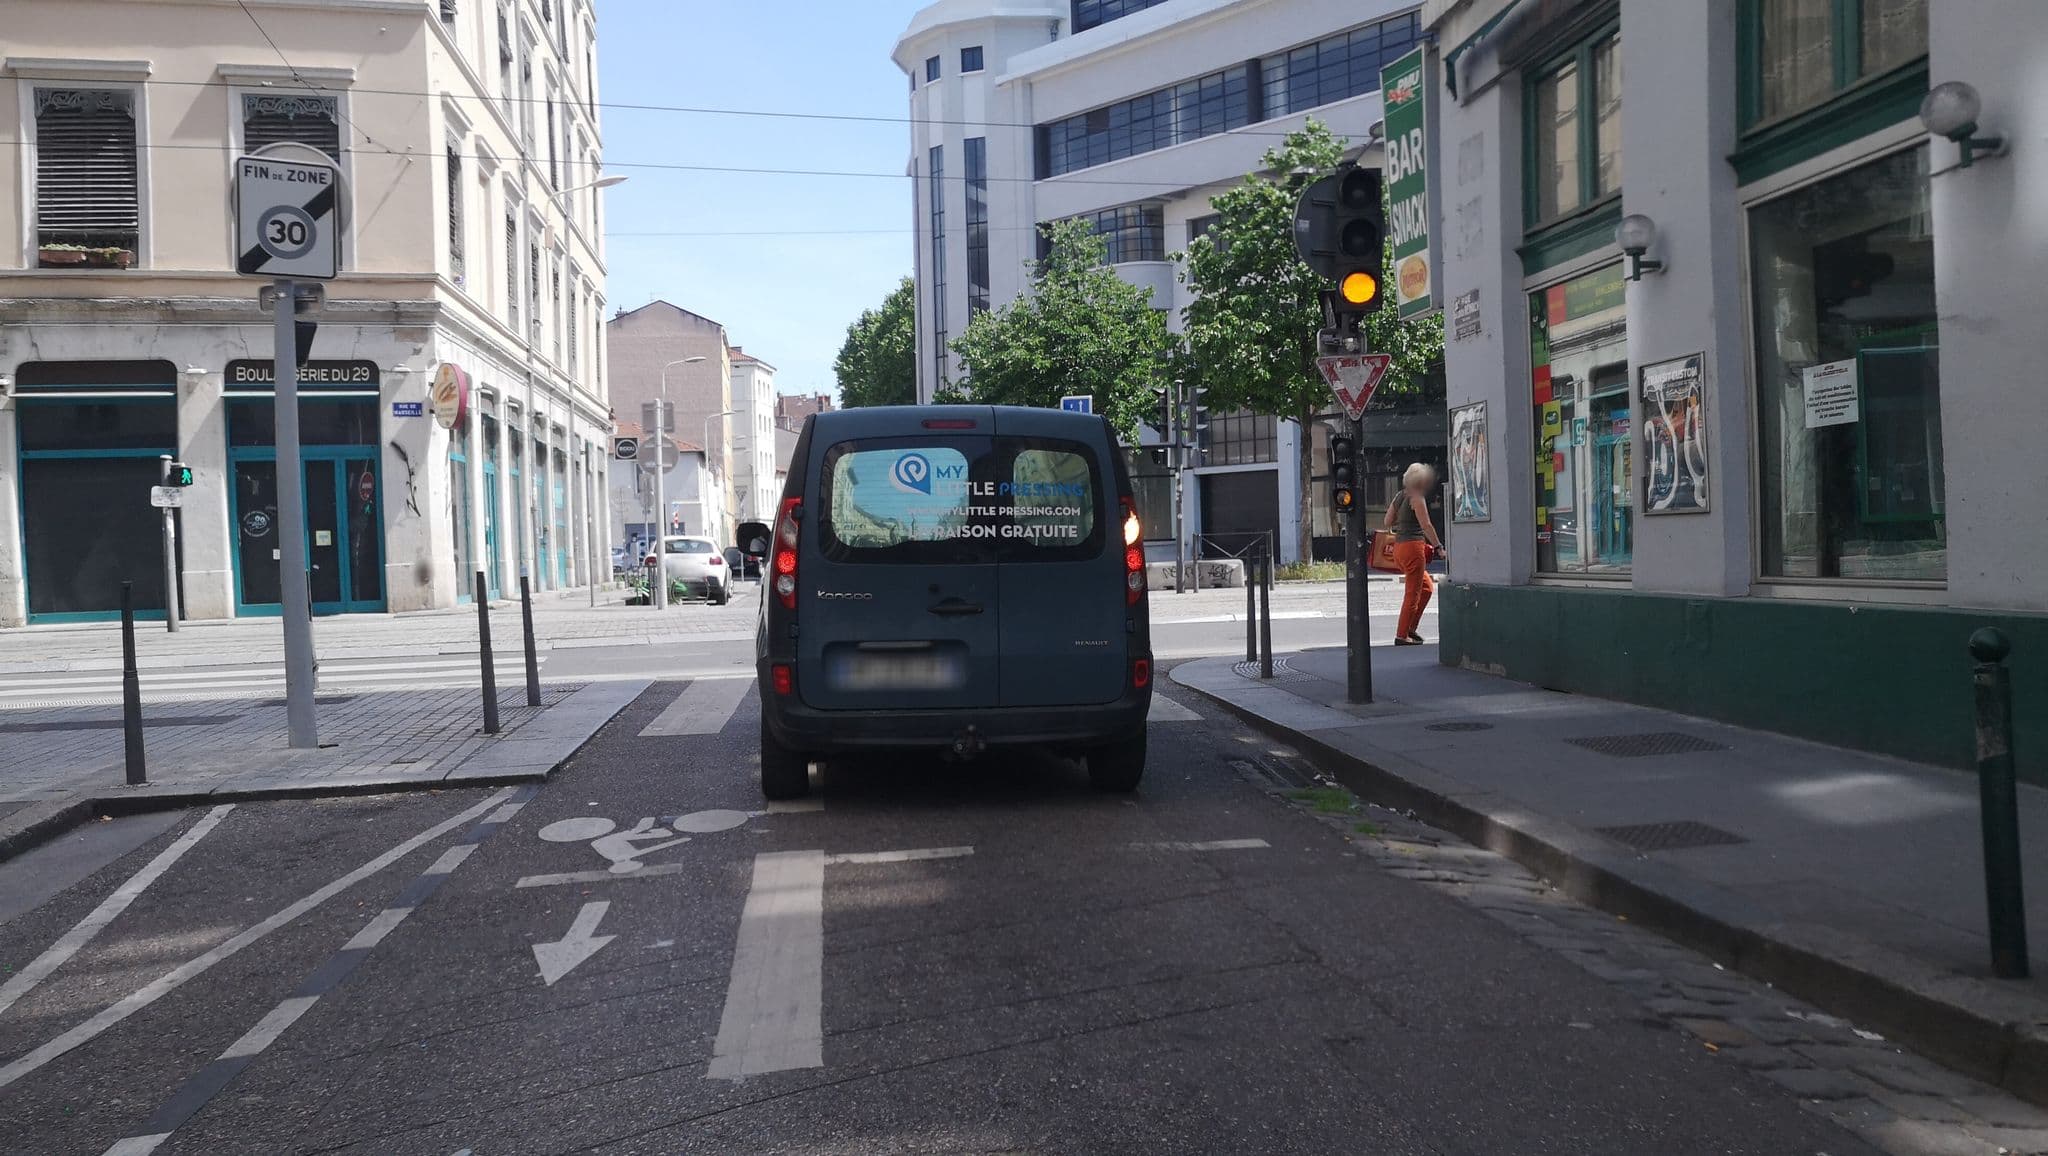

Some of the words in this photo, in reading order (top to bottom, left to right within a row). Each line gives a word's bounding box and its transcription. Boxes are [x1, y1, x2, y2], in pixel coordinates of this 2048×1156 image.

[1387, 127, 1425, 185] BAR
[244, 165, 269, 179] FIN
[287, 169, 329, 185] ZONE
[1392, 191, 1428, 247] SNACK
[269, 219, 307, 246] 30
[332, 368, 350, 382] DU
[352, 367, 371, 382] 29
[936, 465, 964, 479] MY
[936, 481, 996, 496] LITTLE
[999, 481, 1085, 497] PRESSING
[999, 506, 1081, 518] PRESSING.COM
[908, 524, 996, 539] LIVRAISON
[1001, 524, 1078, 539] GRATUITE
